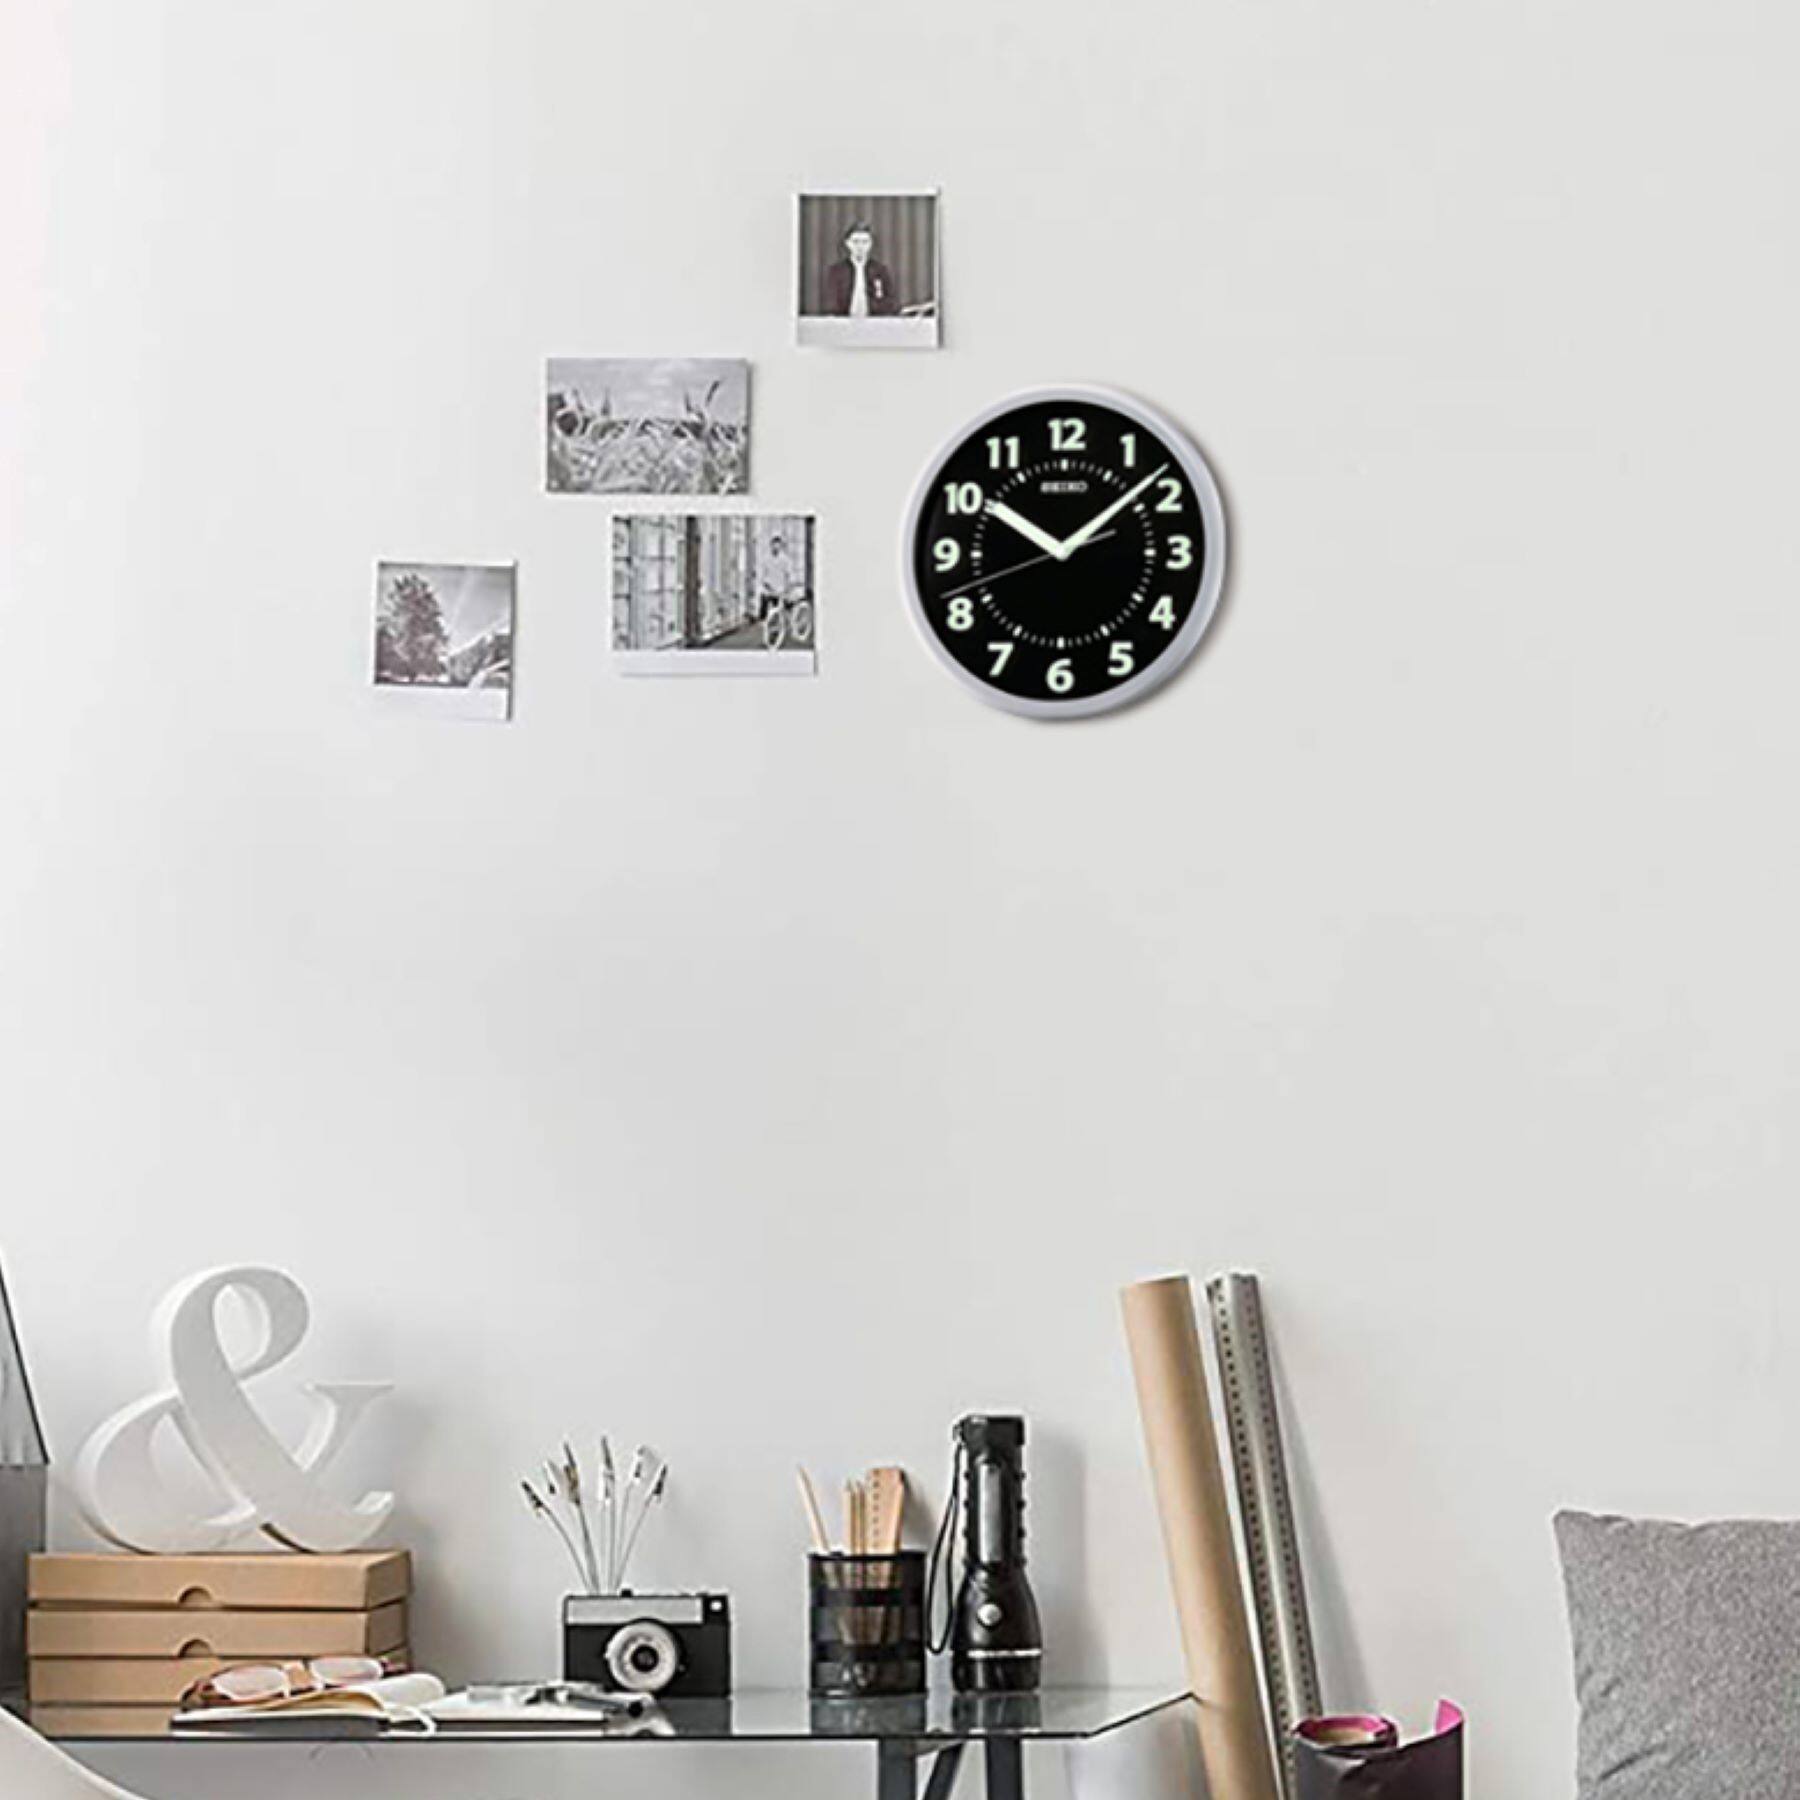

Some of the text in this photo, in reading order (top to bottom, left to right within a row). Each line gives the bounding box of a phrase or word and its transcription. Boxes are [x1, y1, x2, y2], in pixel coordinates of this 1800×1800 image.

[1048, 417, 1086, 451] 12
[1120, 434, 1136, 468] 1
[987, 437, 1019, 469] 11
[945, 483, 982, 515] 10
[1156, 479, 1183, 512] 2
[934, 538, 960, 572] 9
[1167, 535, 1192, 570] 3
[947, 597, 974, 631] 8
[1149, 596, 1176, 630] 4
[987, 643, 1014, 676] 7
[1046, 659, 1074, 693] 6
[1108, 642, 1134, 676] 5
[75, 1265, 394, 1553] &
